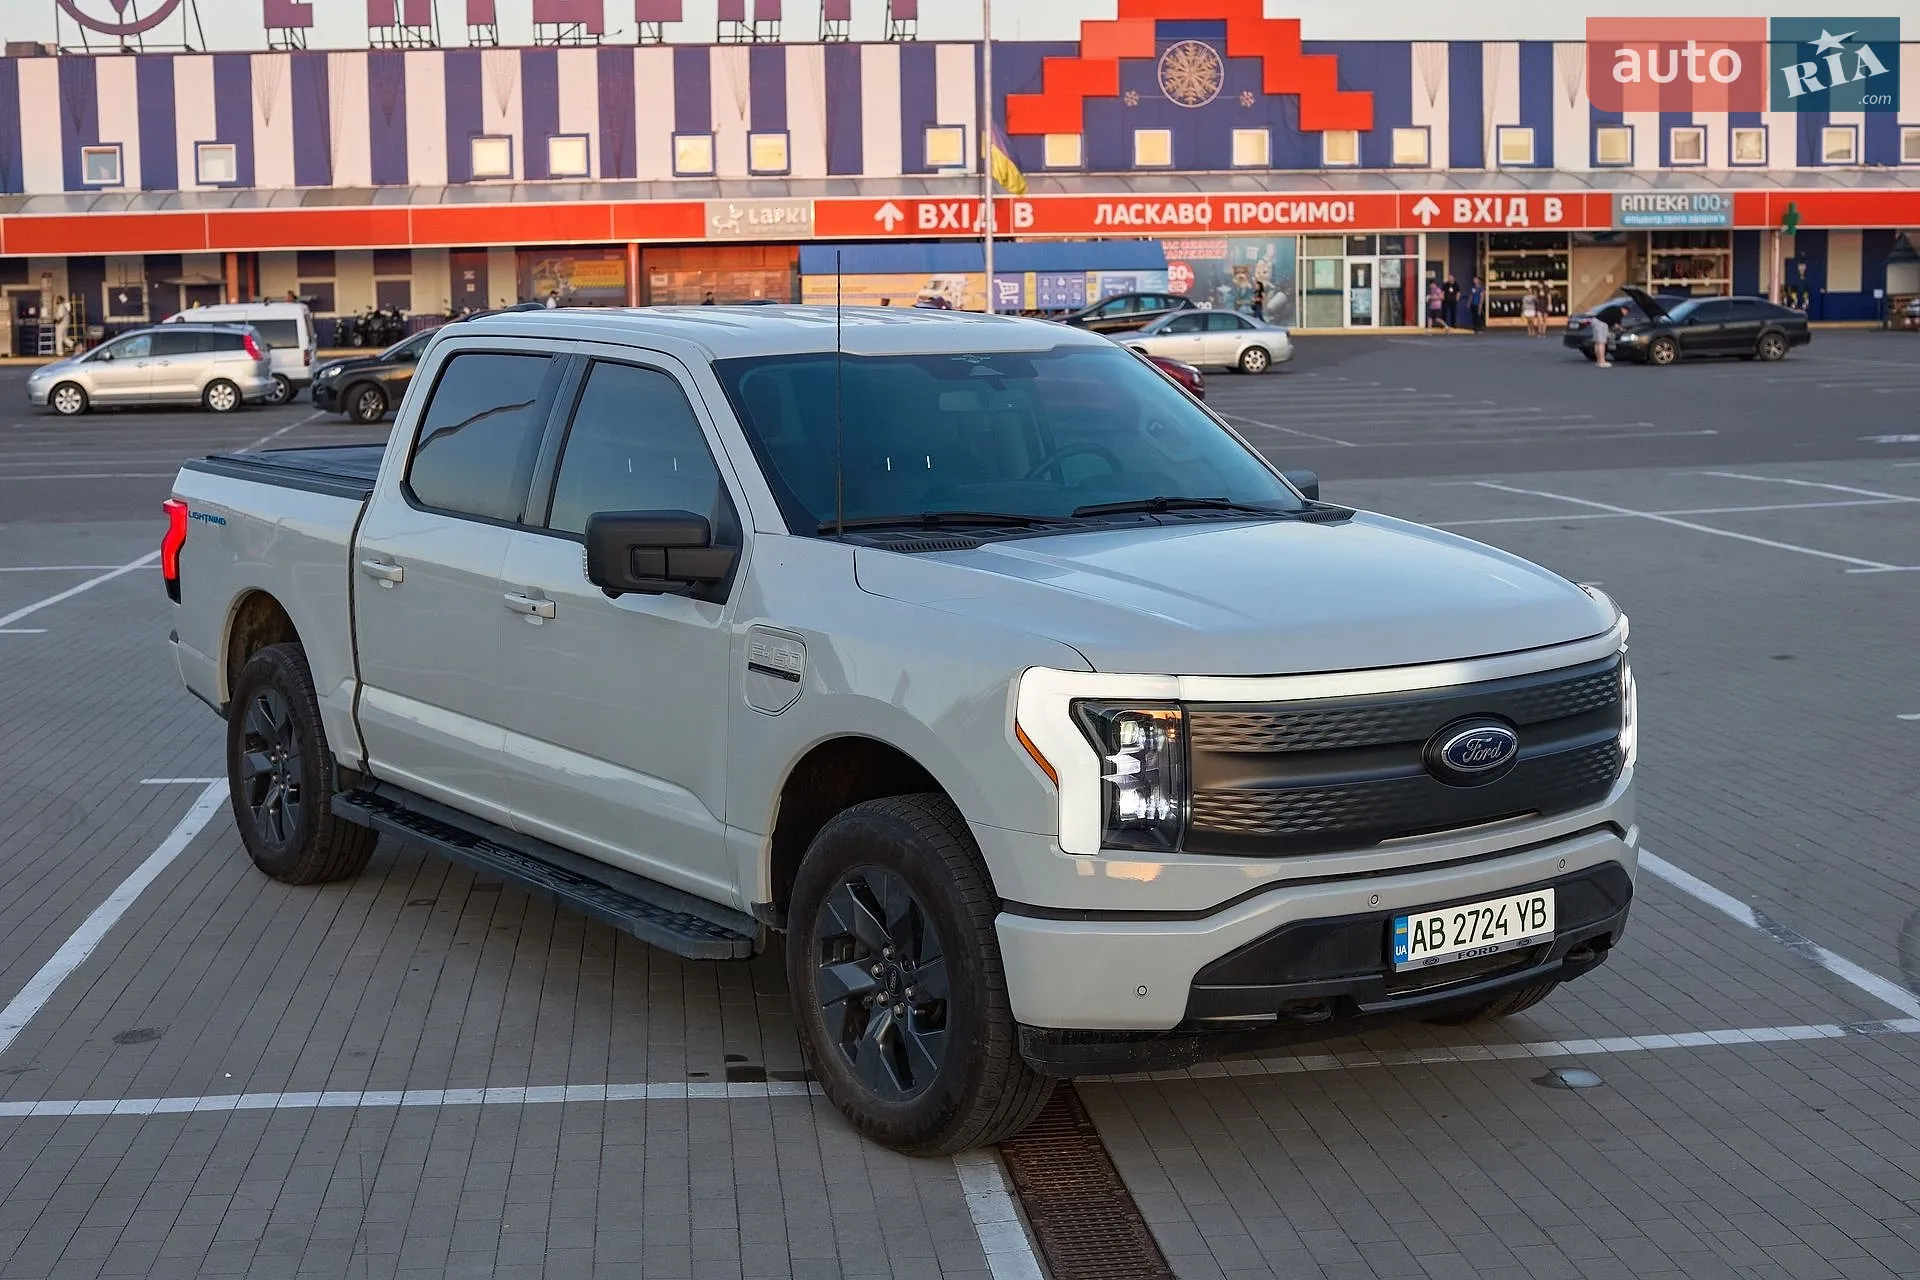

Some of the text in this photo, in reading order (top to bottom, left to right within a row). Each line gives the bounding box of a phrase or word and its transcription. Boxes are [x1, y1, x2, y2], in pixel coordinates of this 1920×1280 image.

[1094, 201, 1355, 225] ЛАСКАВО ПРОСИМО!
[1453, 197, 1563, 227] ВХІД В
[1621, 195, 1689, 211] АПТЕКА
[917, 202, 1034, 233] ВХІД В
[188, 510, 226, 526] LIGHTNING
[1462, 737, 1503, 763] Ford
[1411, 897, 1547, 954] AB 2724 YB
[1395, 945, 1408, 956] UA
[1457, 945, 1499, 960] FORD
